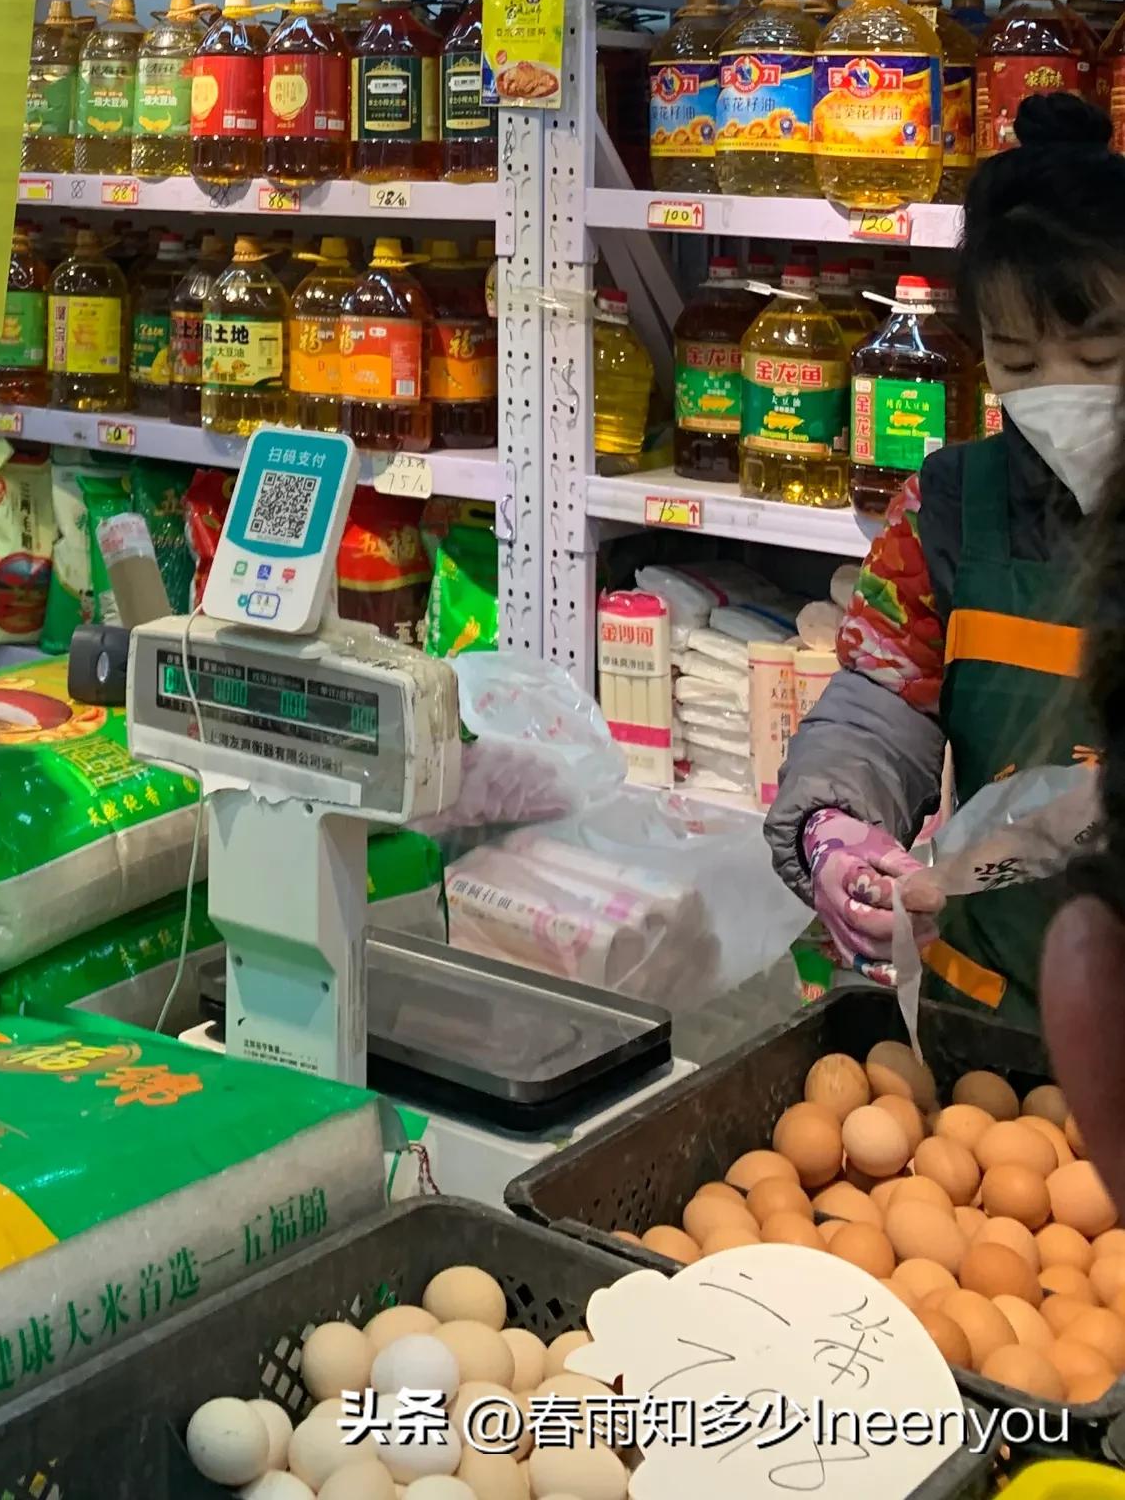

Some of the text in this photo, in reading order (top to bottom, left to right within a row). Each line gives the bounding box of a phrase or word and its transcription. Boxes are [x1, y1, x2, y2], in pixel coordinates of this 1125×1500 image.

[663, 208, 690, 224] 100
[859, 211, 894, 233] 120
[755, 360, 822, 389] 金龙鱼
[856, 395, 870, 460] 金龙鱼
[268, 447, 327, 469] 扫码支付
